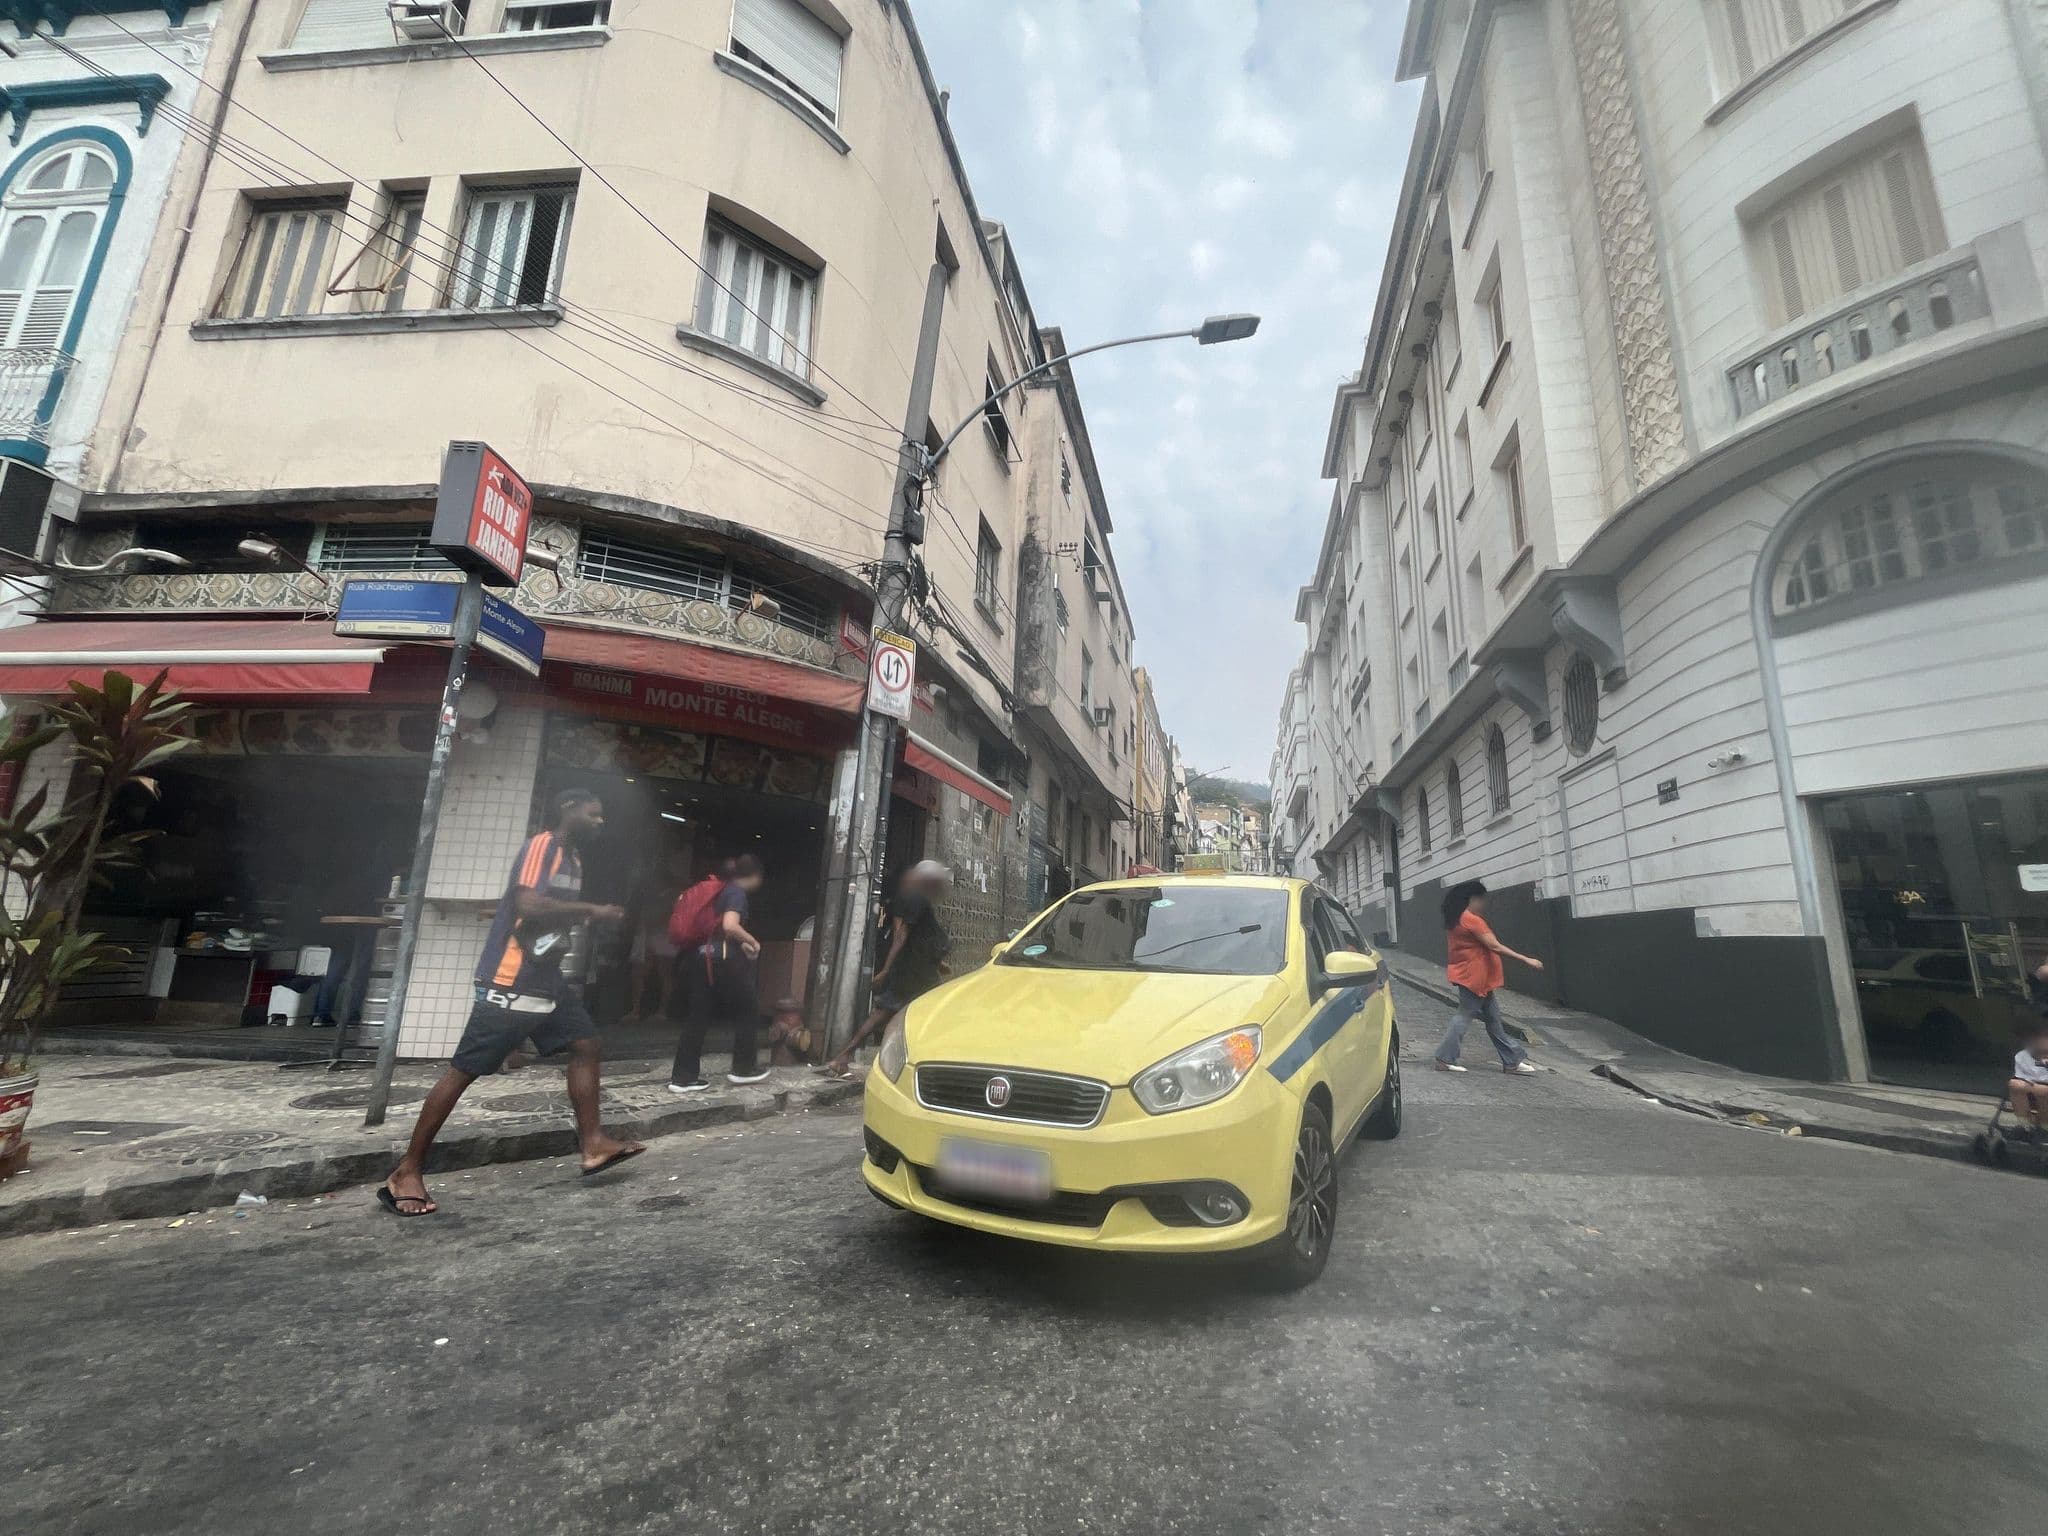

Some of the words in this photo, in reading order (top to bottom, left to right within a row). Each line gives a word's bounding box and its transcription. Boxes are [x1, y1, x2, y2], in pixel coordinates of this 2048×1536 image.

[482, 484, 506, 526] RIO
[503, 503, 520, 538] DE
[475, 518, 520, 575] JANEIRO
[348, 582, 365, 591] Rua
[367, 582, 415, 592] Riachuelo
[484, 594, 499, 609] Rua
[482, 604, 506, 624] Monte
[426, 623, 448, 634] 209
[645, 686, 728, 718] MONTE
[733, 703, 805, 738] ALEGRE
[990, 1085, 1006, 1100] FIAT
